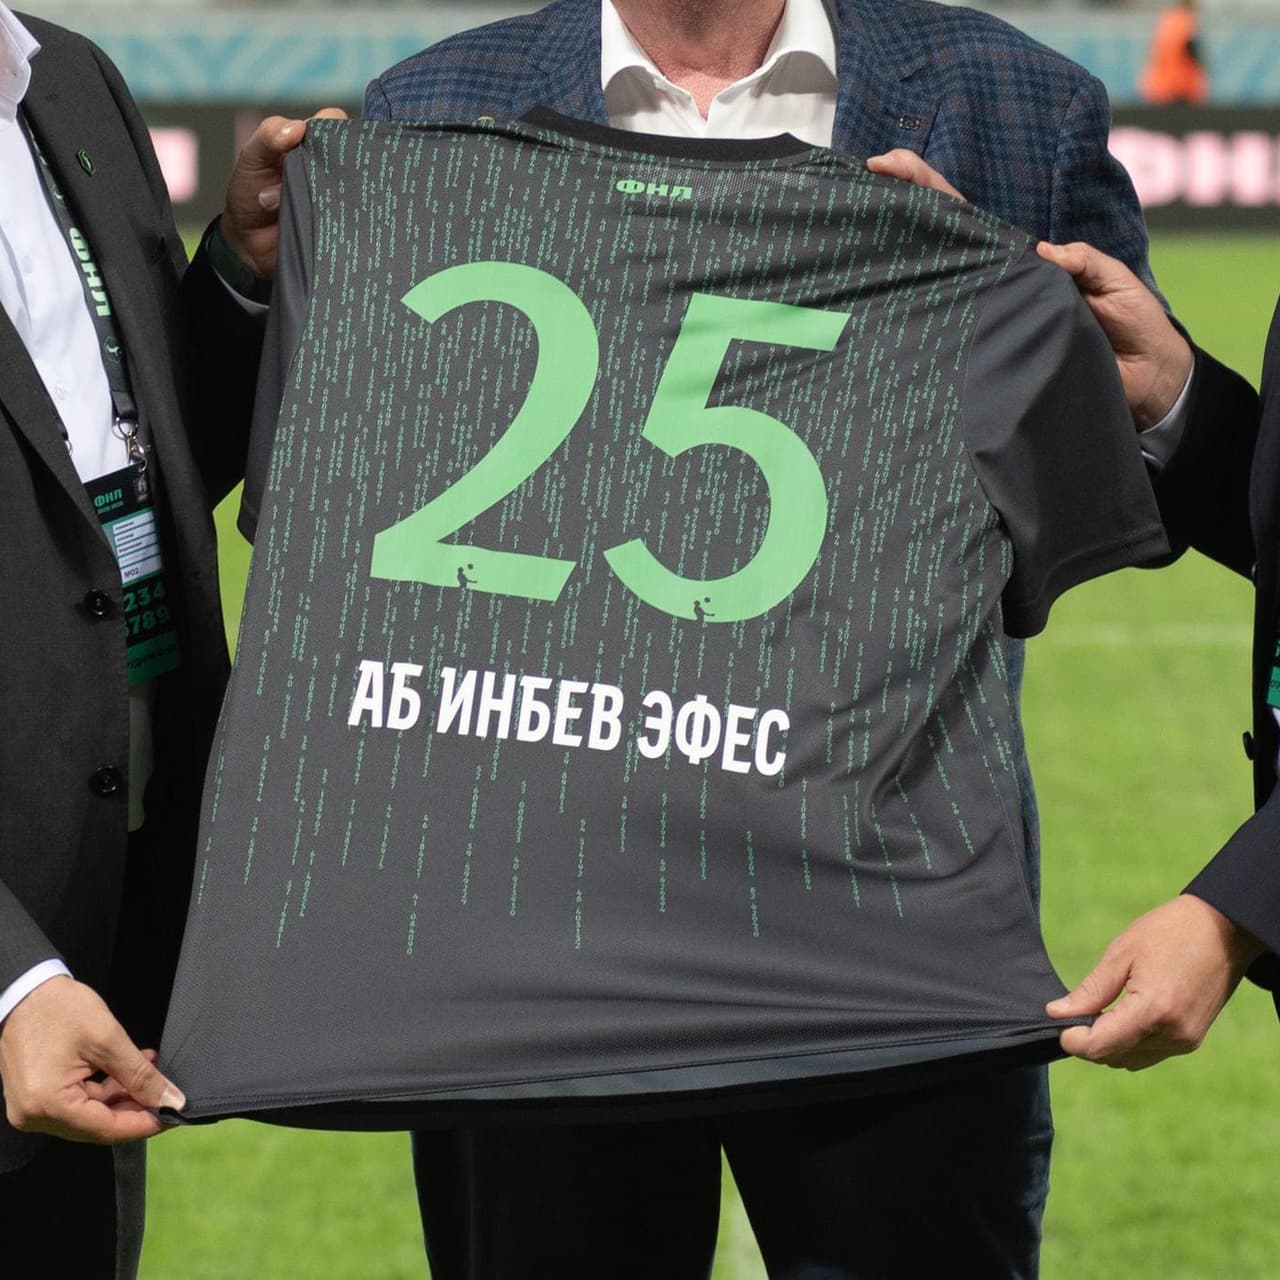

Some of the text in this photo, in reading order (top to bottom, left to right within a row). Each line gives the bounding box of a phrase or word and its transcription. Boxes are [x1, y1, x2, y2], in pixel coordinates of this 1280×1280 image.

[616, 180, 693, 200] ФНЛ
[68, 226, 112, 318] ФНЛ
[370, 261, 852, 623] 25
[348, 659, 791, 777] АБ ИНБЕВ ЭФЕС
